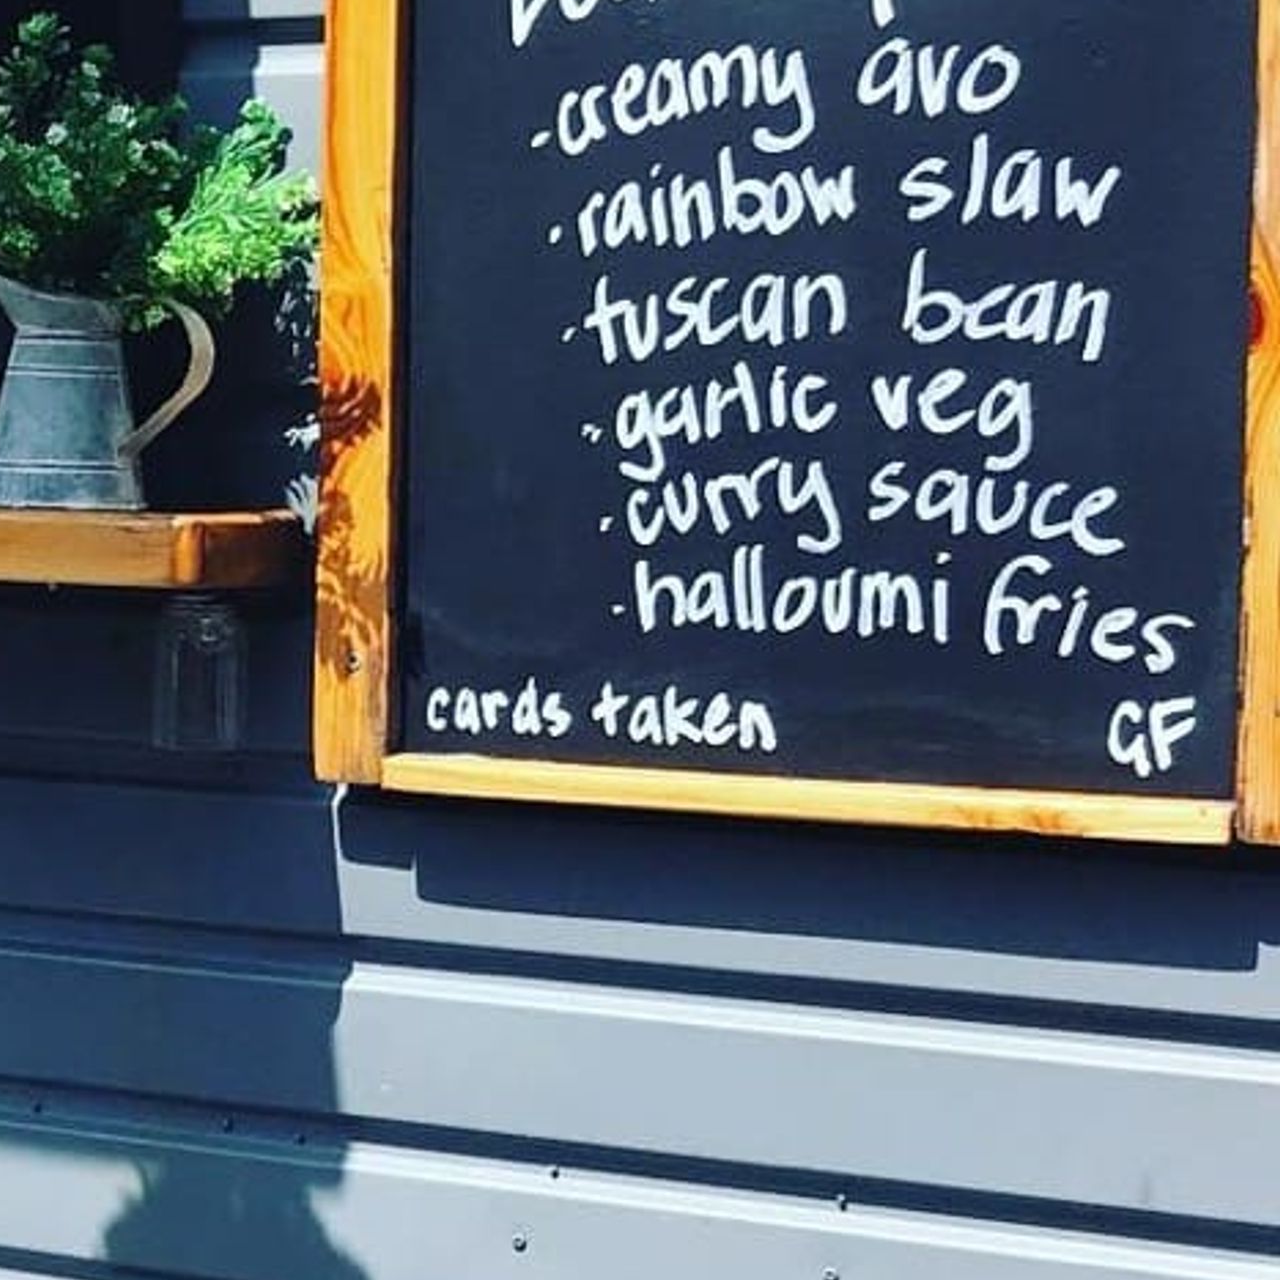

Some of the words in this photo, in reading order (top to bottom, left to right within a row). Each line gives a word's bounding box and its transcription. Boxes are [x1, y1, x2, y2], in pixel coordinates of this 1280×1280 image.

[557, 44, 816, 154] creamy
[856, 36, 1022, 118] avo
[578, 145, 856, 257] rainbow
[898, 133, 1121, 227] slaw
[583, 274, 847, 364] tuscan
[902, 247, 1110, 362] bean
[616, 361, 837, 482] garlic
[870, 367, 1033, 472] veg
[627, 455, 842, 555] curry
[868, 460, 1126, 558] sauce
[634, 544, 951, 644] halloumi
[982, 554, 1196, 675] fries
[425, 676, 572, 738] cards
[591, 682, 778, 752] taken
[1106, 695, 1198, 778] GF
